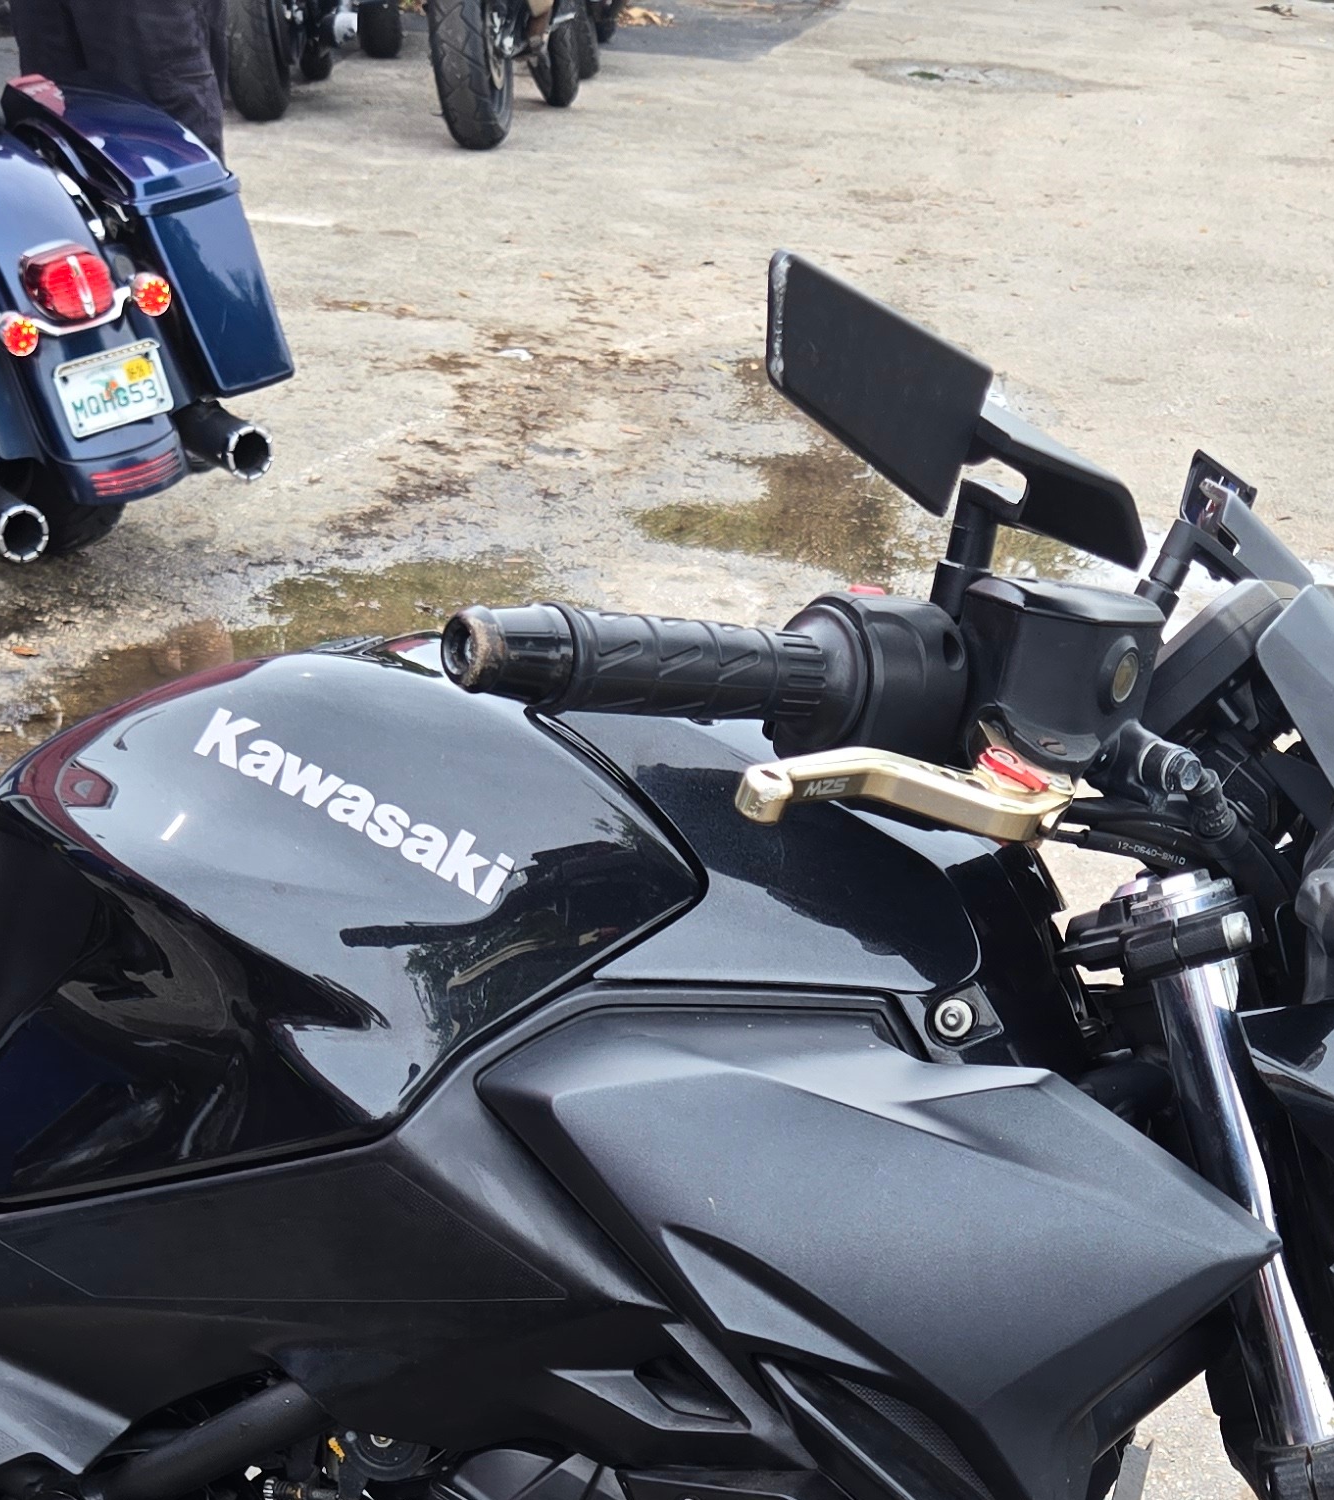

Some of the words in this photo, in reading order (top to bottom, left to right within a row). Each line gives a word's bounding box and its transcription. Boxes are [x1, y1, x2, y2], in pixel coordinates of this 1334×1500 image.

[71, 379, 158, 421] MQHG53
[193, 707, 516, 905] Kawasaki
[802, 777, 850, 797] MZS
